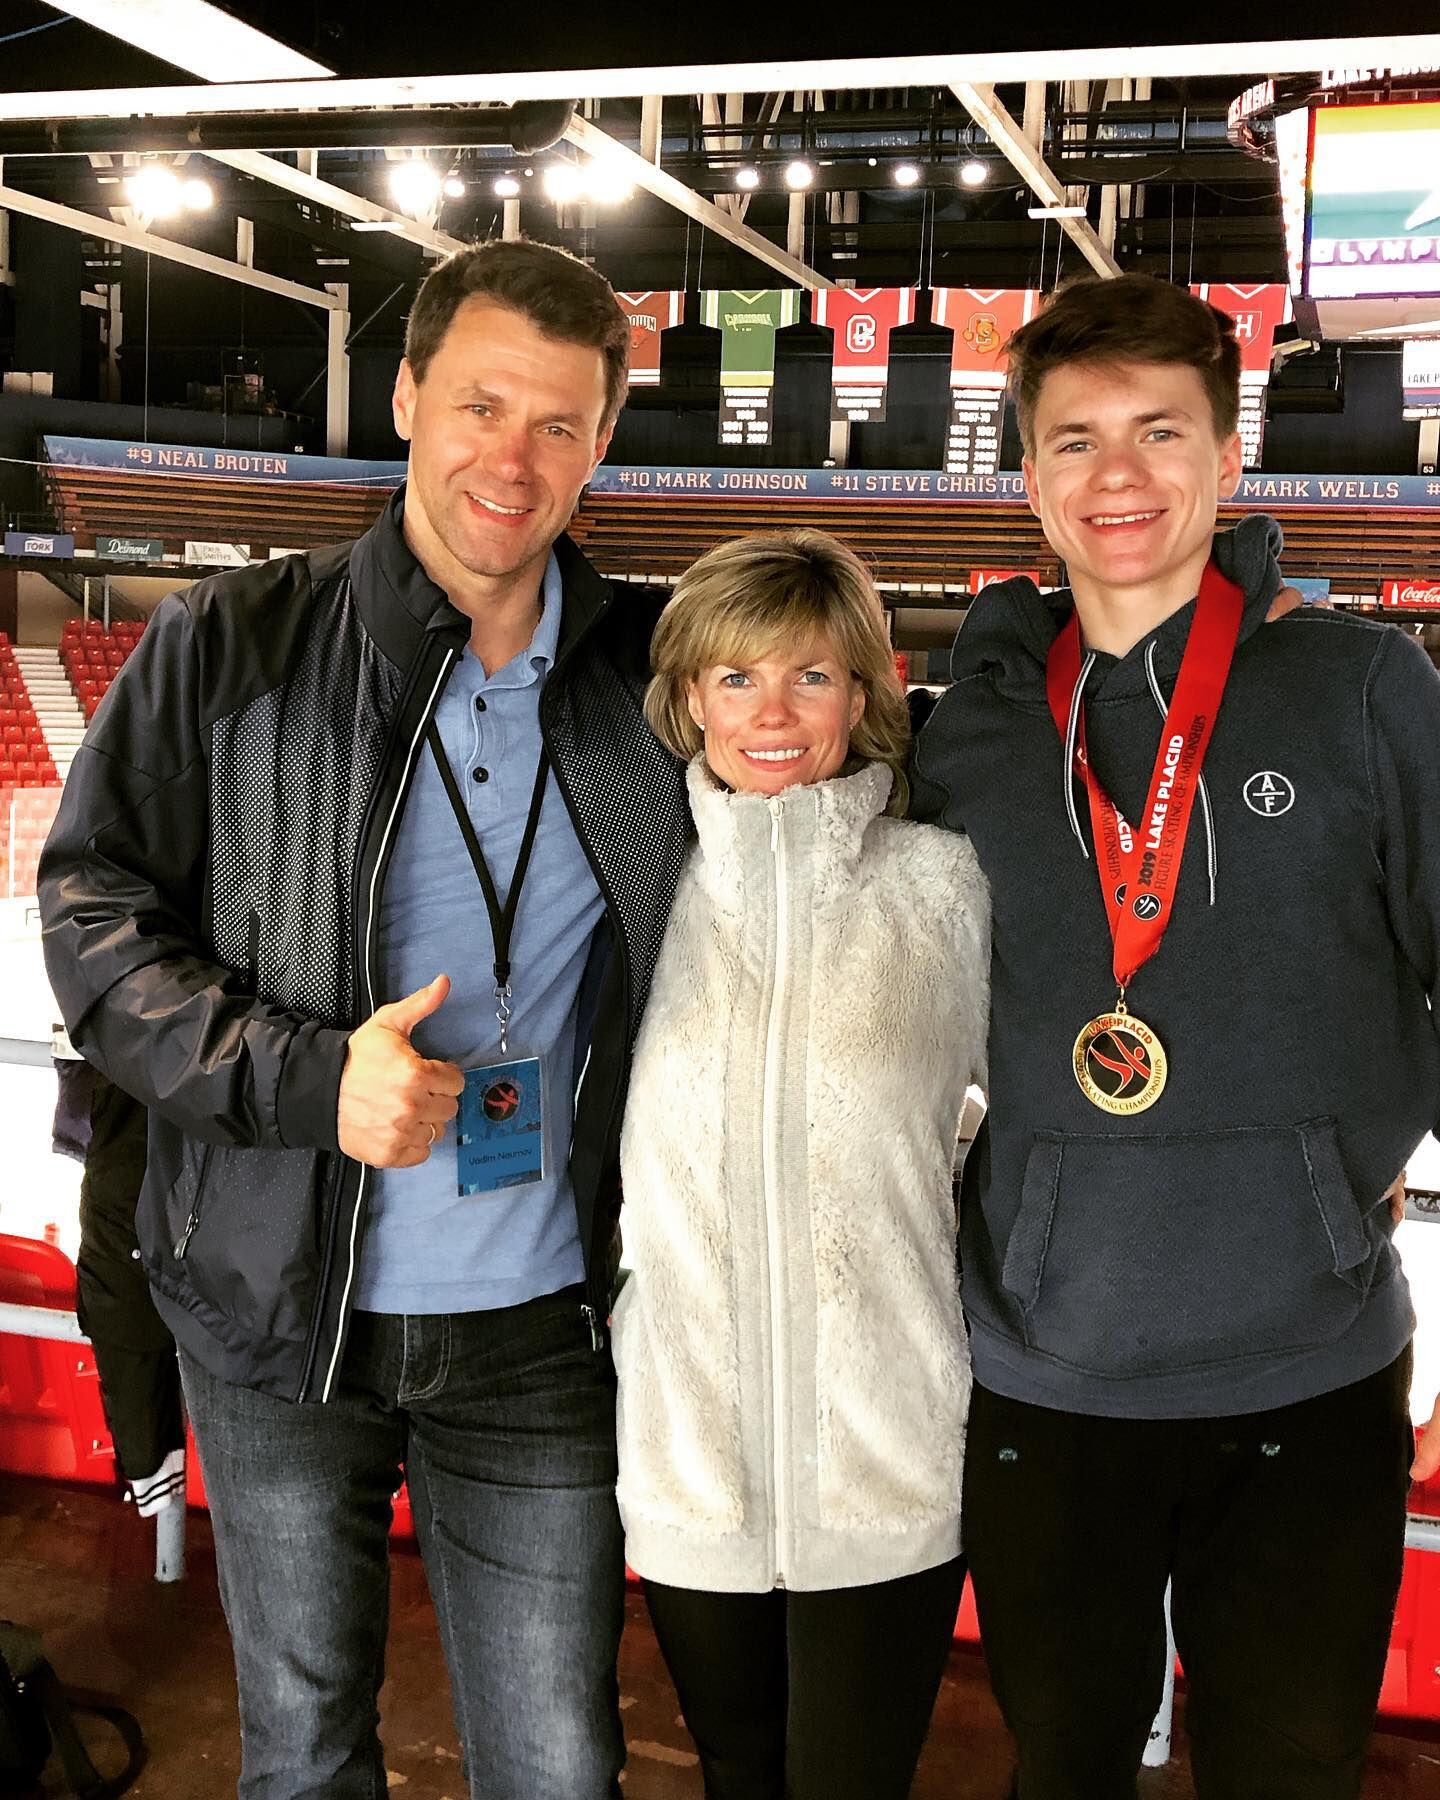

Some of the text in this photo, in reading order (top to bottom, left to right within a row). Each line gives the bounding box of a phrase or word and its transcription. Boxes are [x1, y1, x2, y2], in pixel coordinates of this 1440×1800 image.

[1311, 240, 1440, 264] OLYMP
[626, 314, 657, 332] OWN
[1235, 314, 1253, 338] H
[126, 447, 288, 474] #9 NEAL BROTEN
[618, 471, 807, 490] #10 MARK JOHNSON
[830, 475, 1024, 493] #11 STEVE CHRISTO
[1242, 480, 1400, 498] MARK WELLS
[26, 542, 52, 552] TORK
[107, 539, 150, 555] Desmond
[1414, 623, 1424, 635] 7
[1138, 735, 1184, 887] 2019 LAKE PLACID
[1154, 714, 1207, 890] FIGURE SKATING CHAMPIONSHIPS
[1112, 802, 1133, 853] ACID
[1117, 1018, 1153, 1045] PLACID
